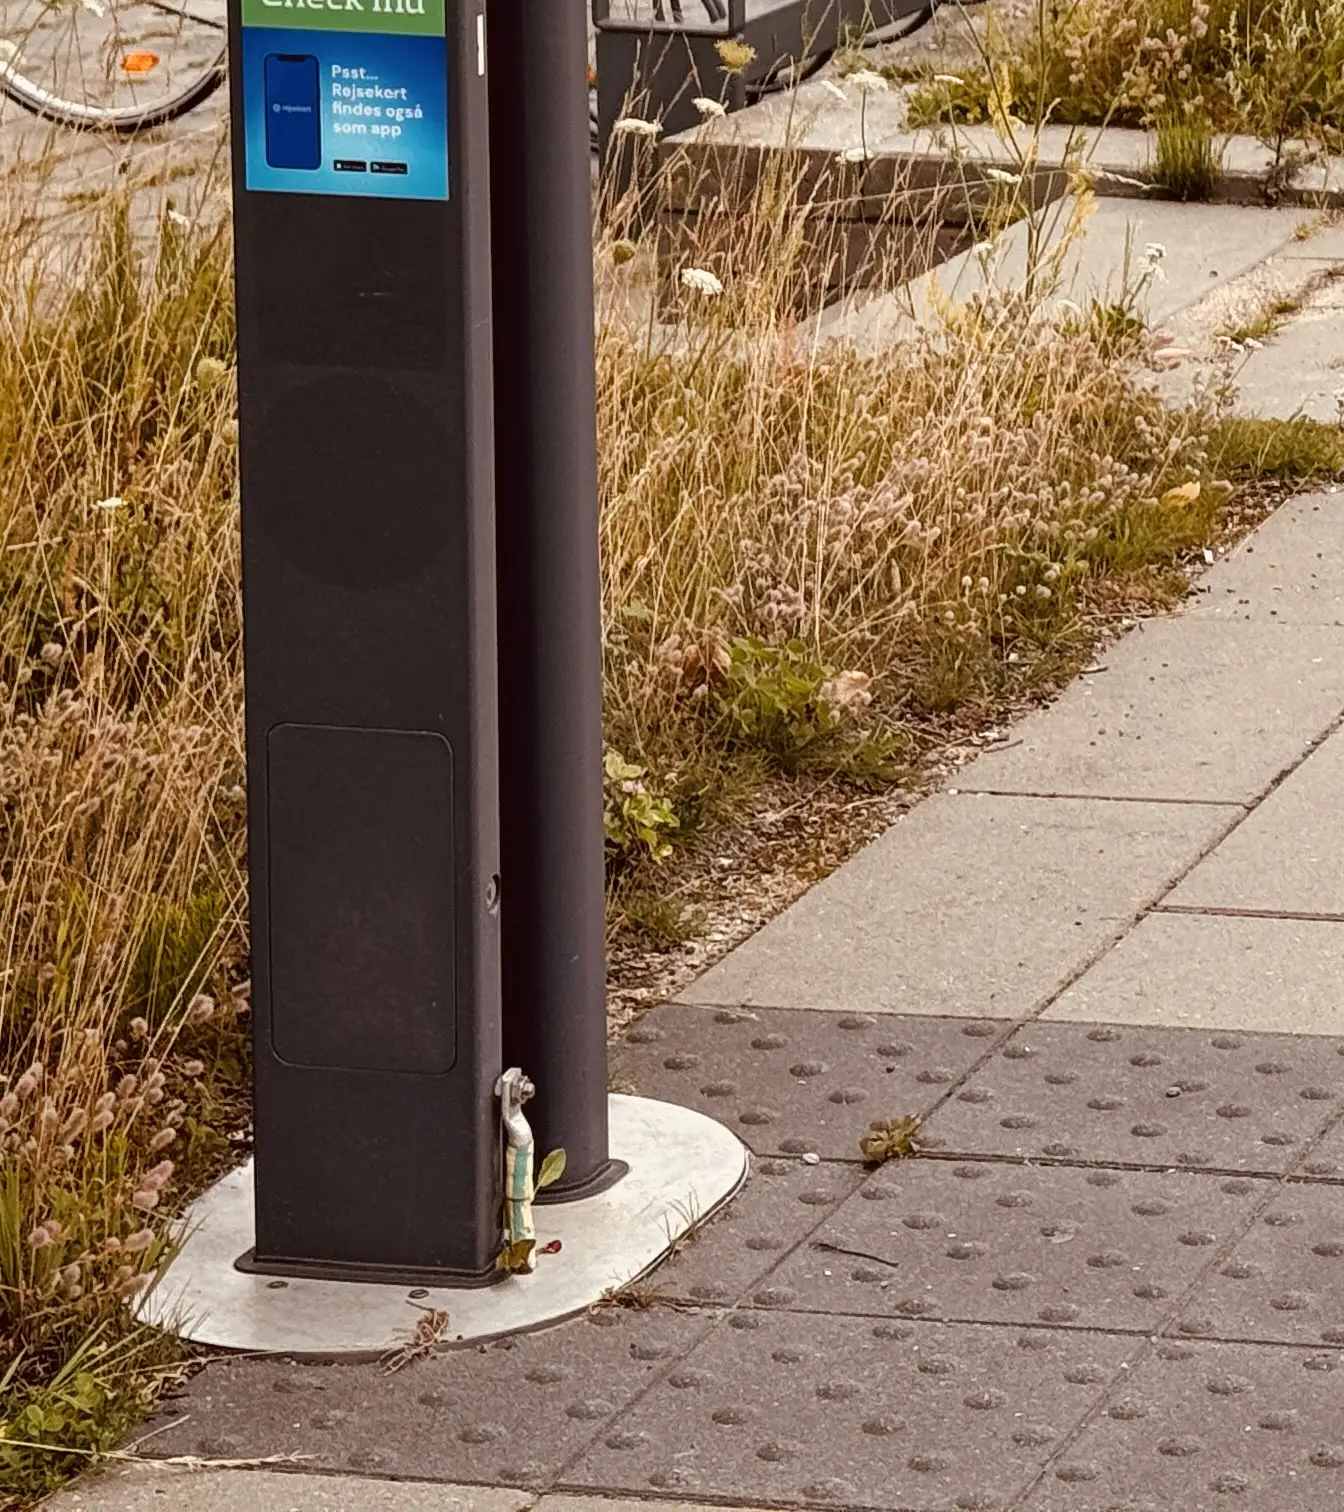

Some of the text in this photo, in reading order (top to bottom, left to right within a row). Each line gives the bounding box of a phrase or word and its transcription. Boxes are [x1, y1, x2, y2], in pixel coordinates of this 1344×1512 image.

[331, 64, 379, 80] Psst...
[332, 100, 424, 122] findes også
[333, 122, 402, 140] som app
